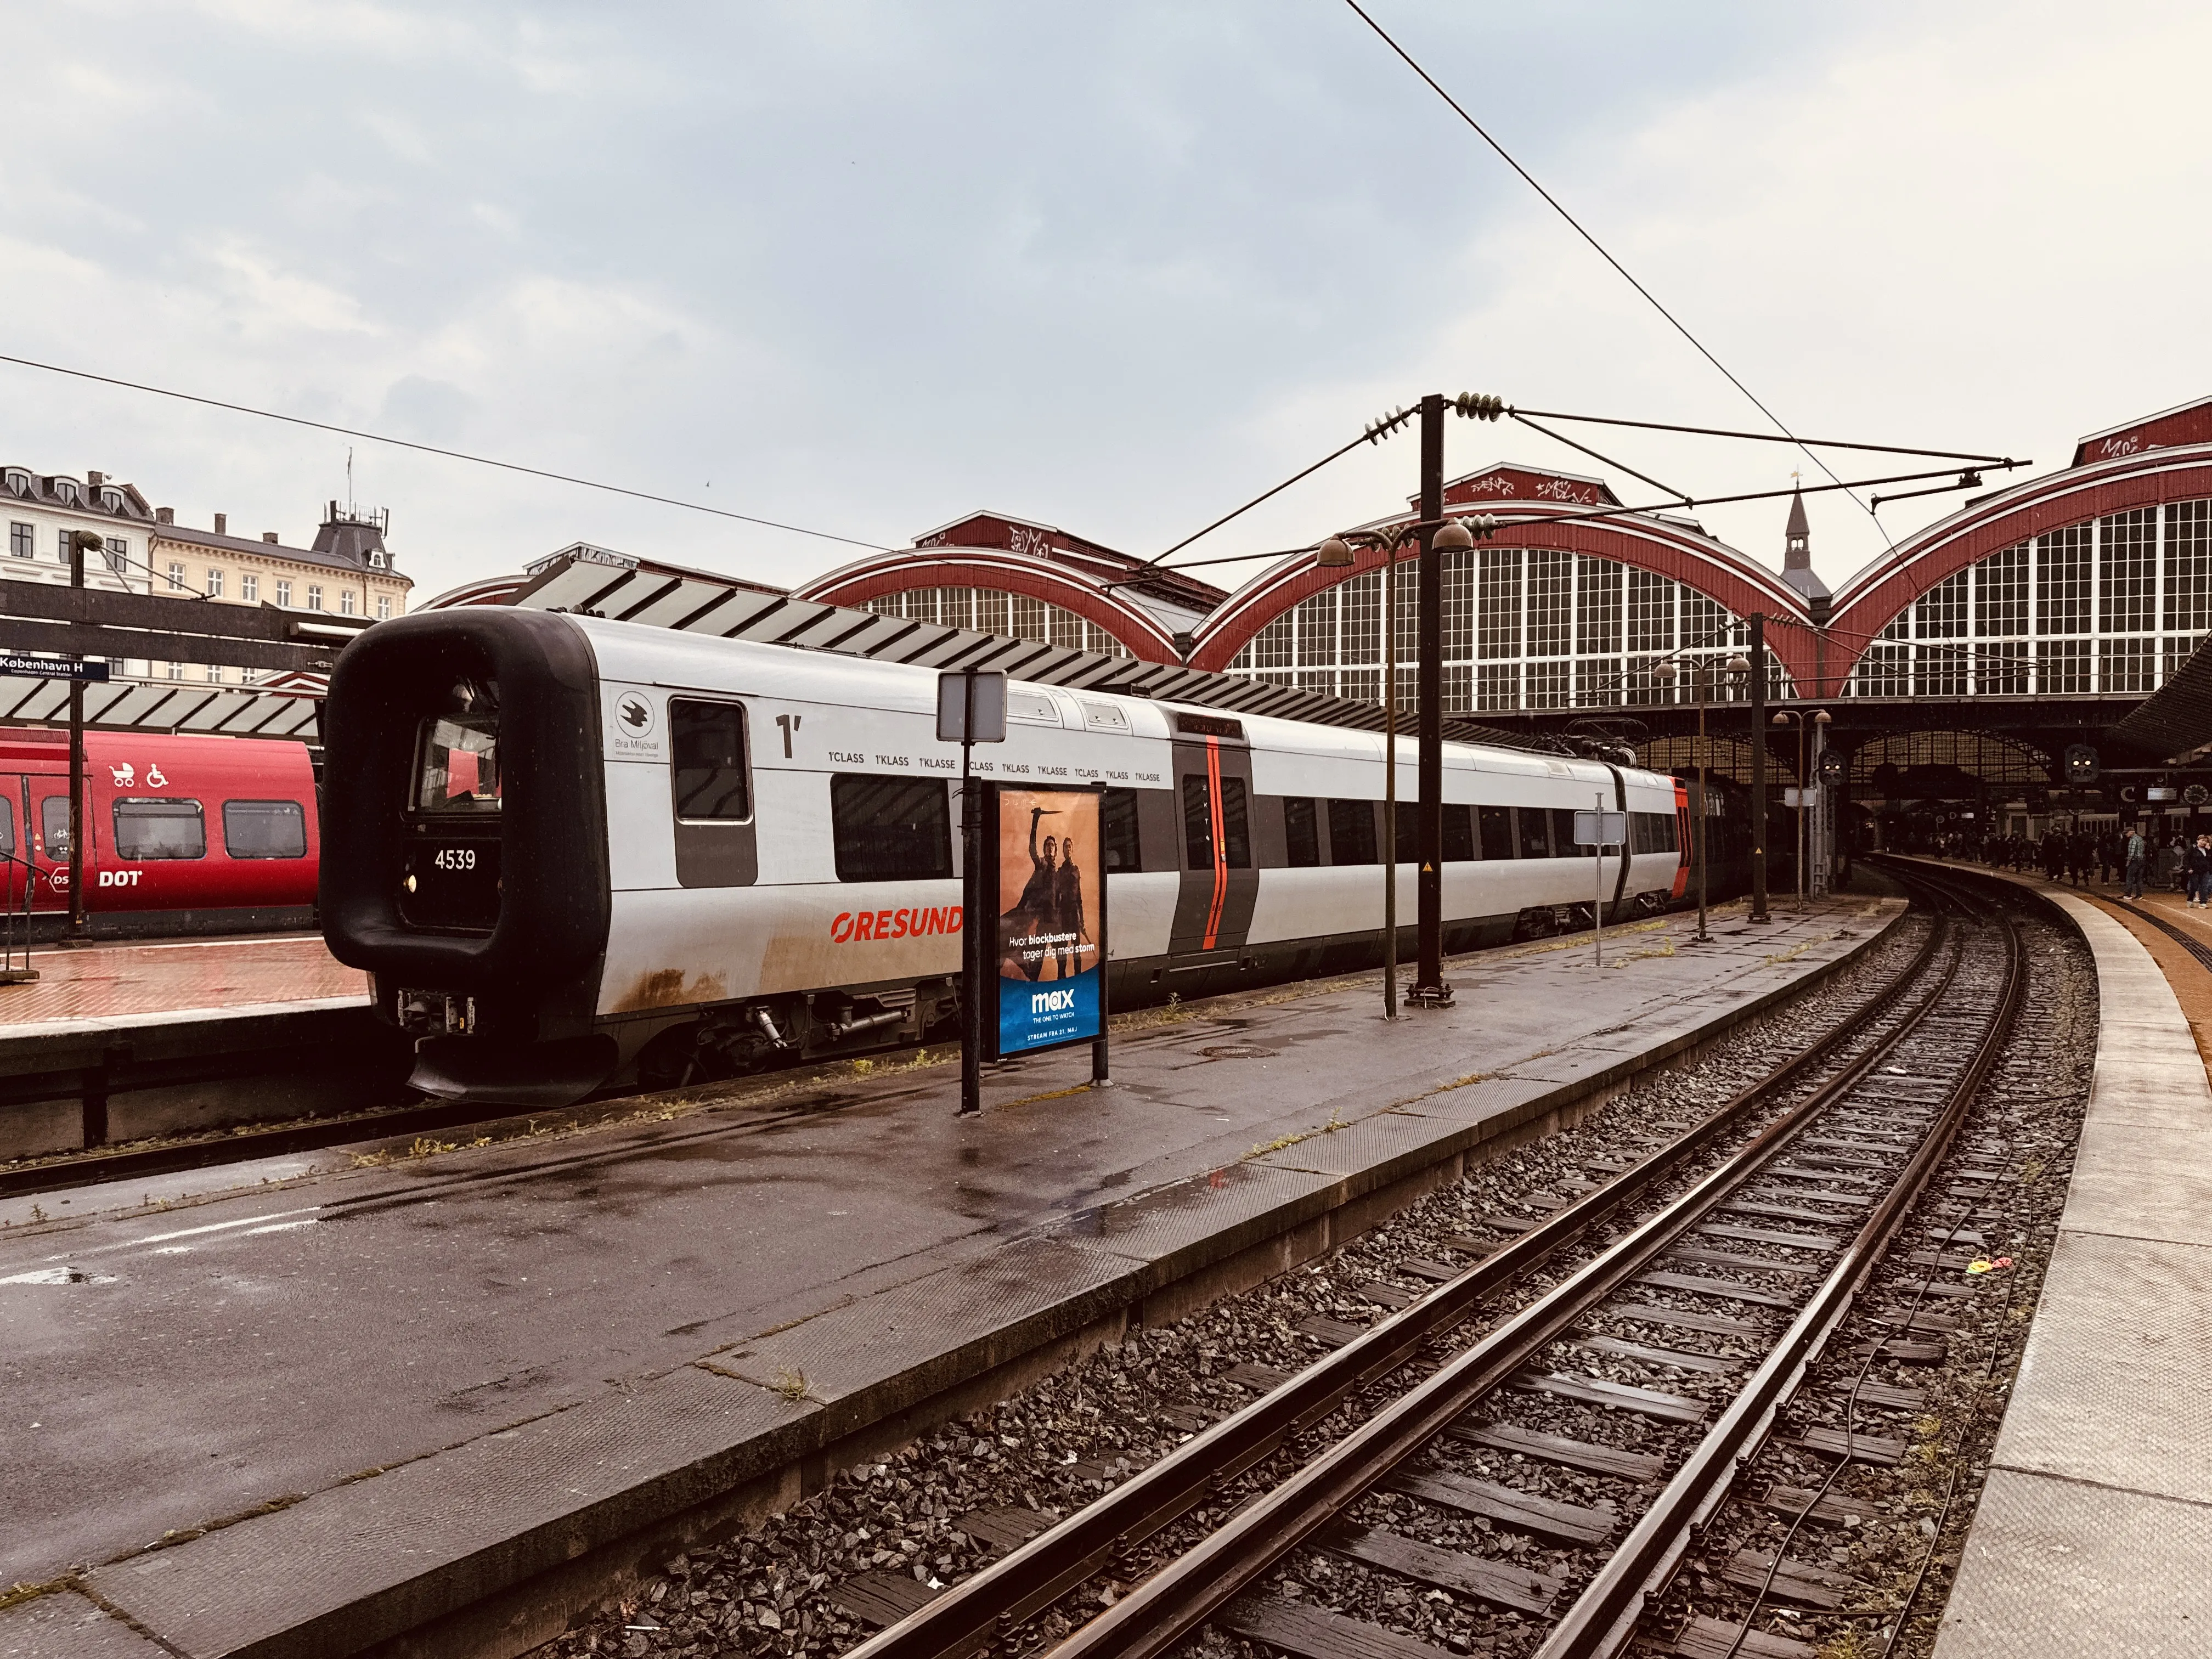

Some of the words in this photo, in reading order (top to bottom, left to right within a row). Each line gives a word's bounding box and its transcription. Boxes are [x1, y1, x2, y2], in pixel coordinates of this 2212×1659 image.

[0, 657, 70, 672] København
[74, 663, 82, 672] H
[615, 738, 628, 748] Bra
[969, 761, 994, 771] CLASS
[435, 849, 475, 870] 4539
[54, 876, 69, 884] DS
[1009, 936, 1027, 947] Hvor
[1029, 932, 1076, 945] blockbustere
[1023, 950, 1043, 961] tager
[1044, 946, 1056, 959] dig
[1058, 943, 1074, 956] med
[1075, 943, 1095, 953] storm
[1032, 989, 1074, 1014] max
[1027, 1032, 1047, 1041] STREAM
